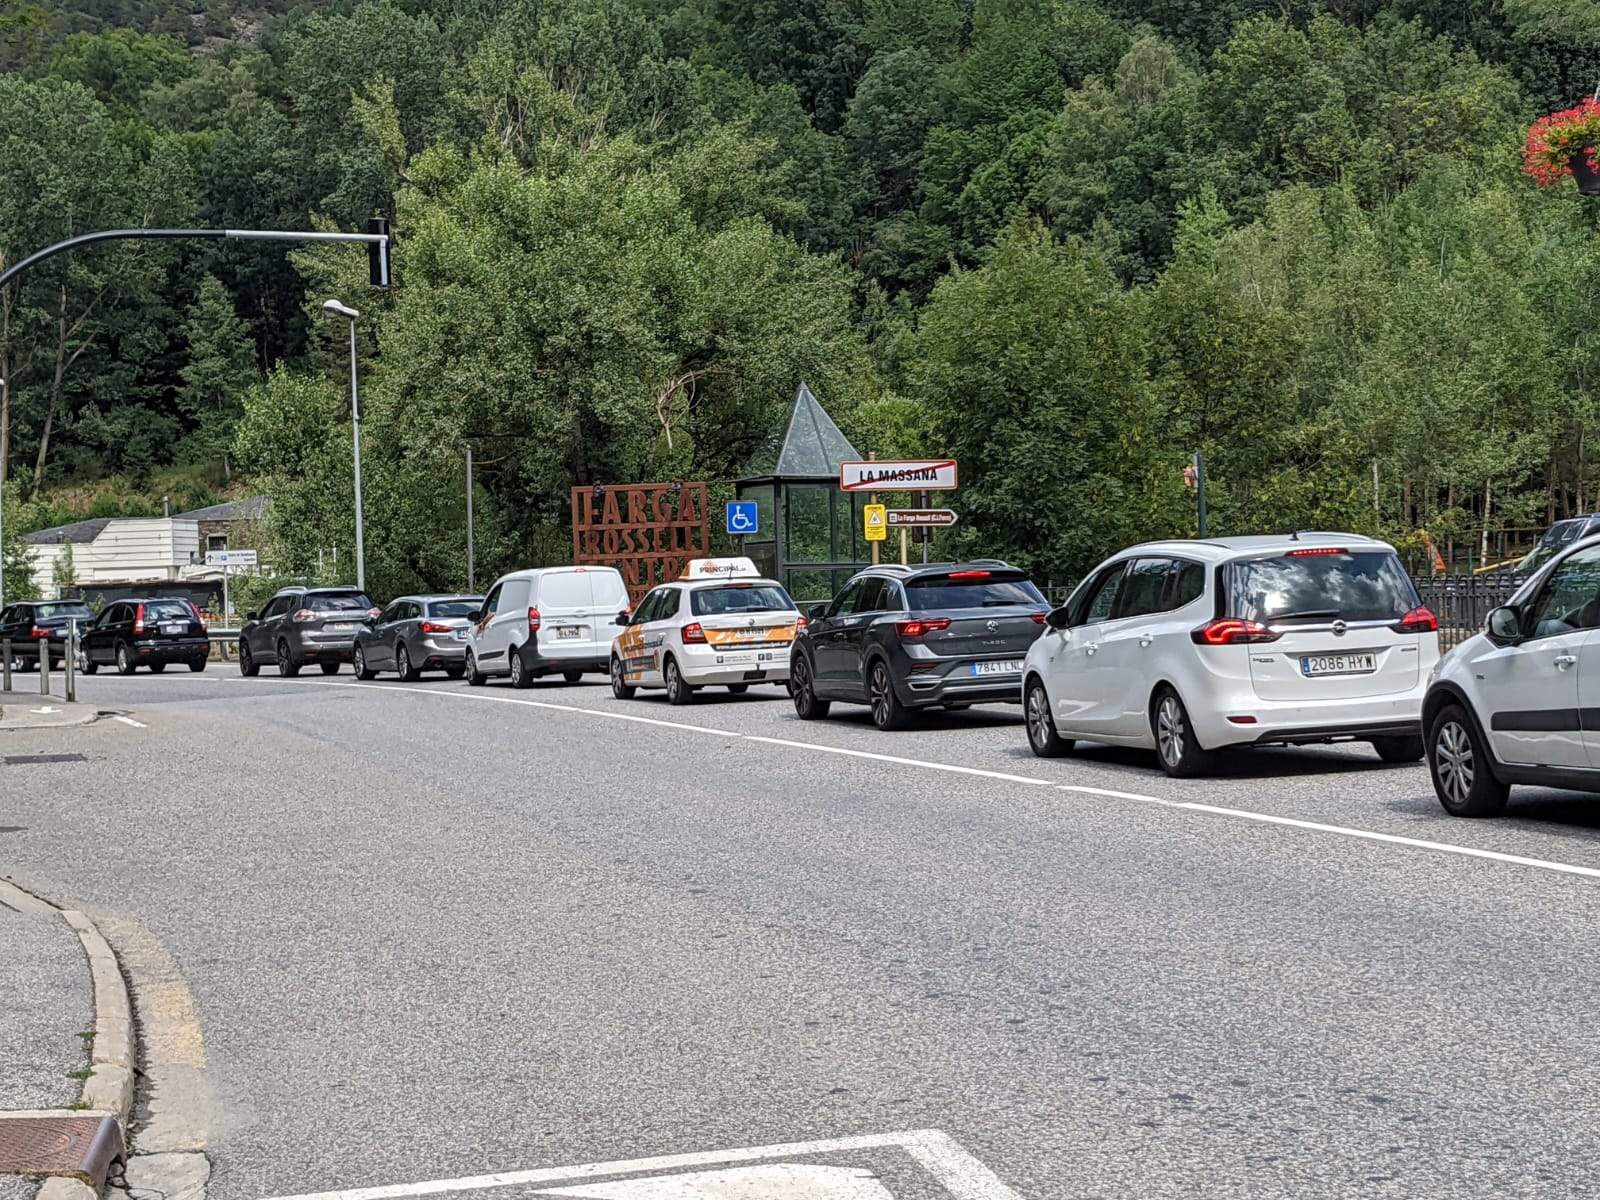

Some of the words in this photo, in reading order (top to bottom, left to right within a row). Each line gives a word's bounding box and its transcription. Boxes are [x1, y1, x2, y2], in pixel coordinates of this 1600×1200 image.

[860, 470, 874, 482] LA
[879, 468, 938, 482] MASSANA
[583, 489, 697, 524] FARGA
[585, 527, 696, 554] ROSSELL
[977, 662, 1001, 673] 7841
[1310, 656, 1344, 671] 2086
[1348, 655, 1373, 669] HYW
